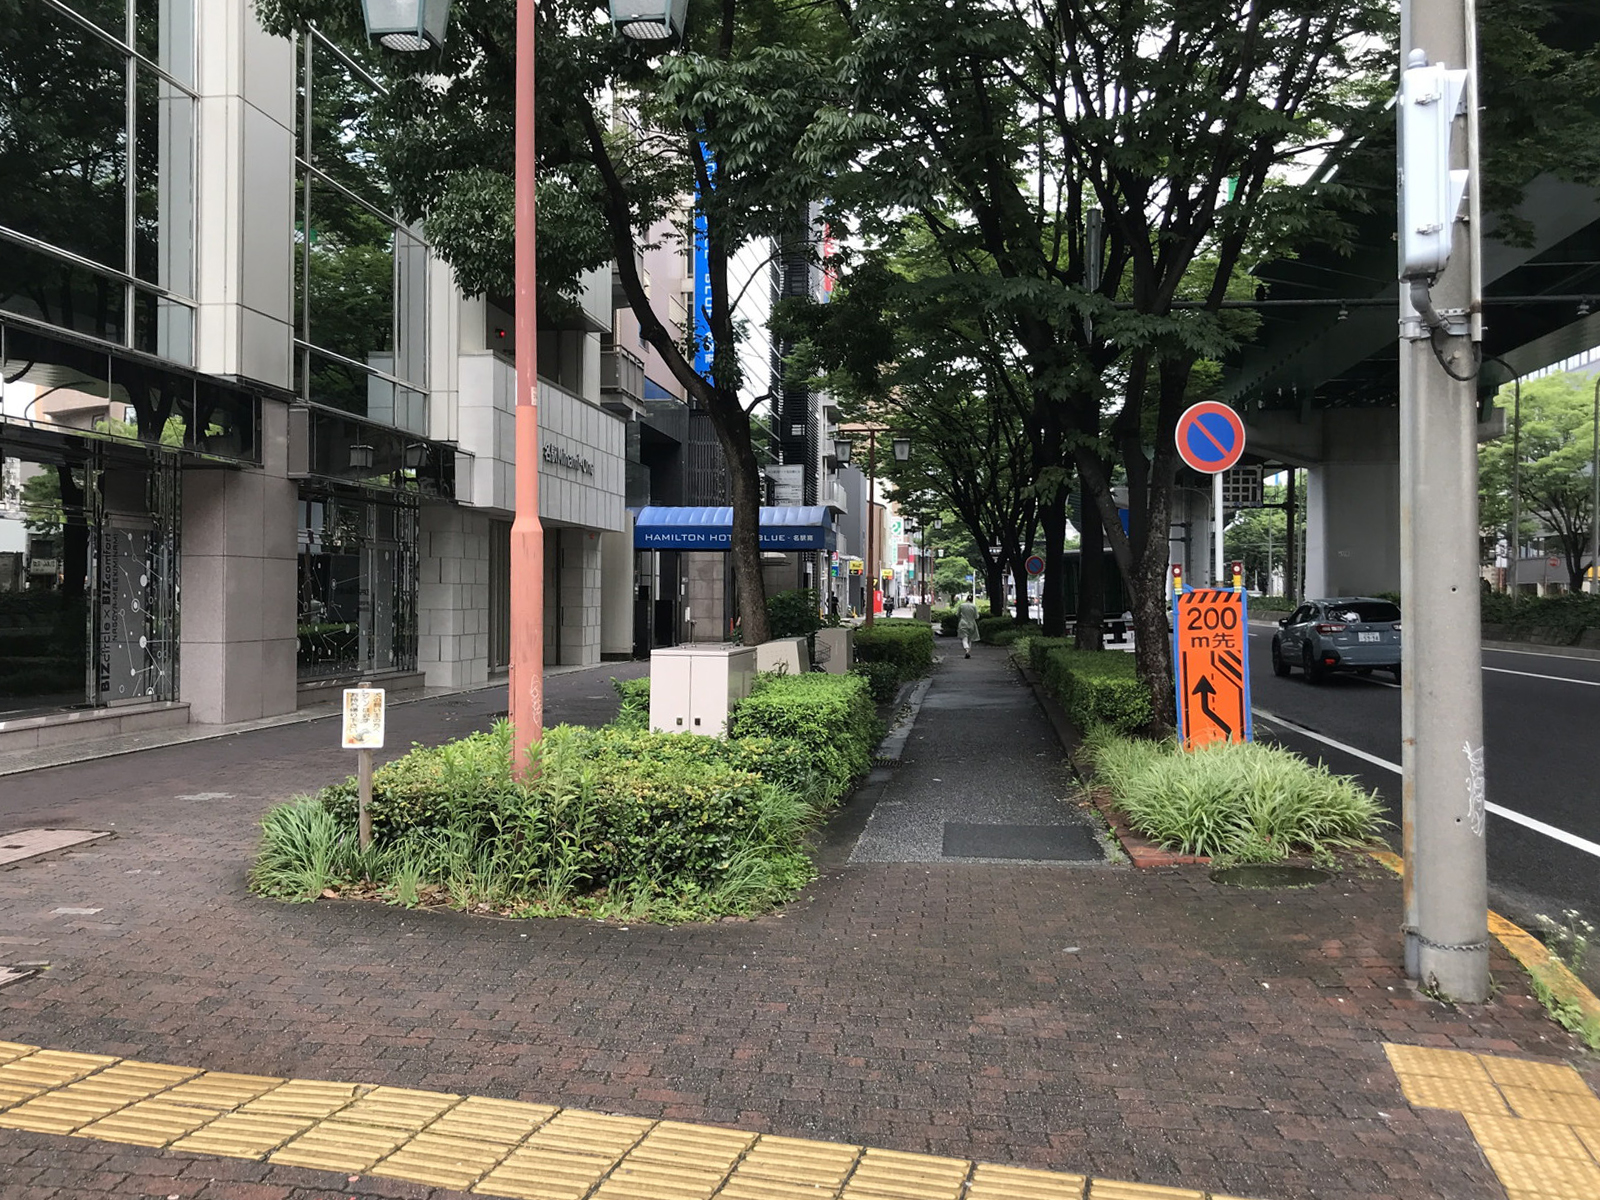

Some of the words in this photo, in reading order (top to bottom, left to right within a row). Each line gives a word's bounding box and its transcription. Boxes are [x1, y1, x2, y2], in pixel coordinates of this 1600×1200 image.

[644, 533, 706, 542] HAMILTON
[102, 533, 112, 605] BIZcomfort
[1187, 606, 1237, 631] 200
[1191, 632, 1235, 649] m先
[100, 621, 111, 692] BIZcircle
